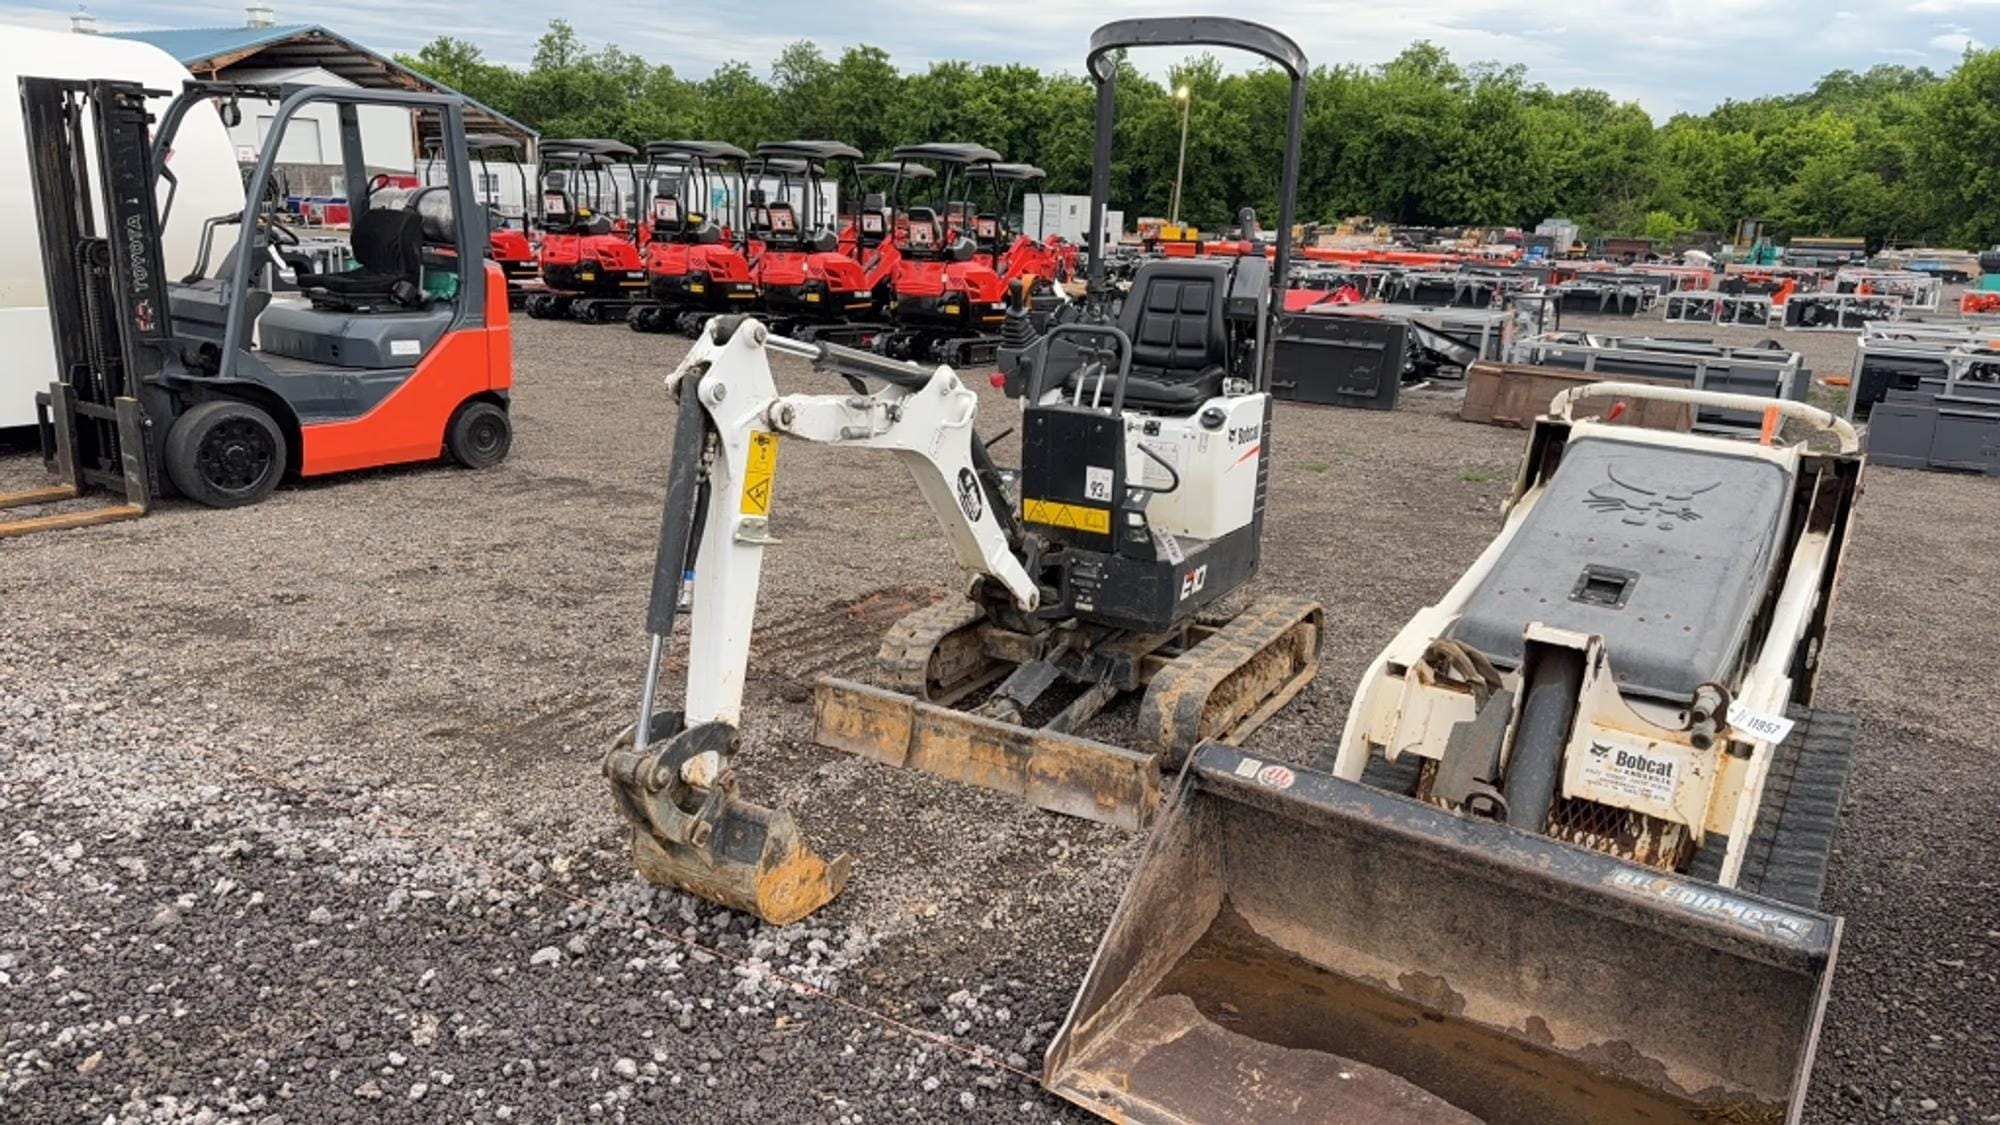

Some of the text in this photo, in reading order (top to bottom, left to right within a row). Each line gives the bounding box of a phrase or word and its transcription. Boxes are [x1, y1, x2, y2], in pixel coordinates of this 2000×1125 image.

[126, 214, 149, 293] TOYOTA
[1089, 480, 1105, 498] 93
[1179, 564, 1208, 601] E10
[1615, 750, 1674, 778] Bobcat
[1612, 868, 1678, 899] BLE
